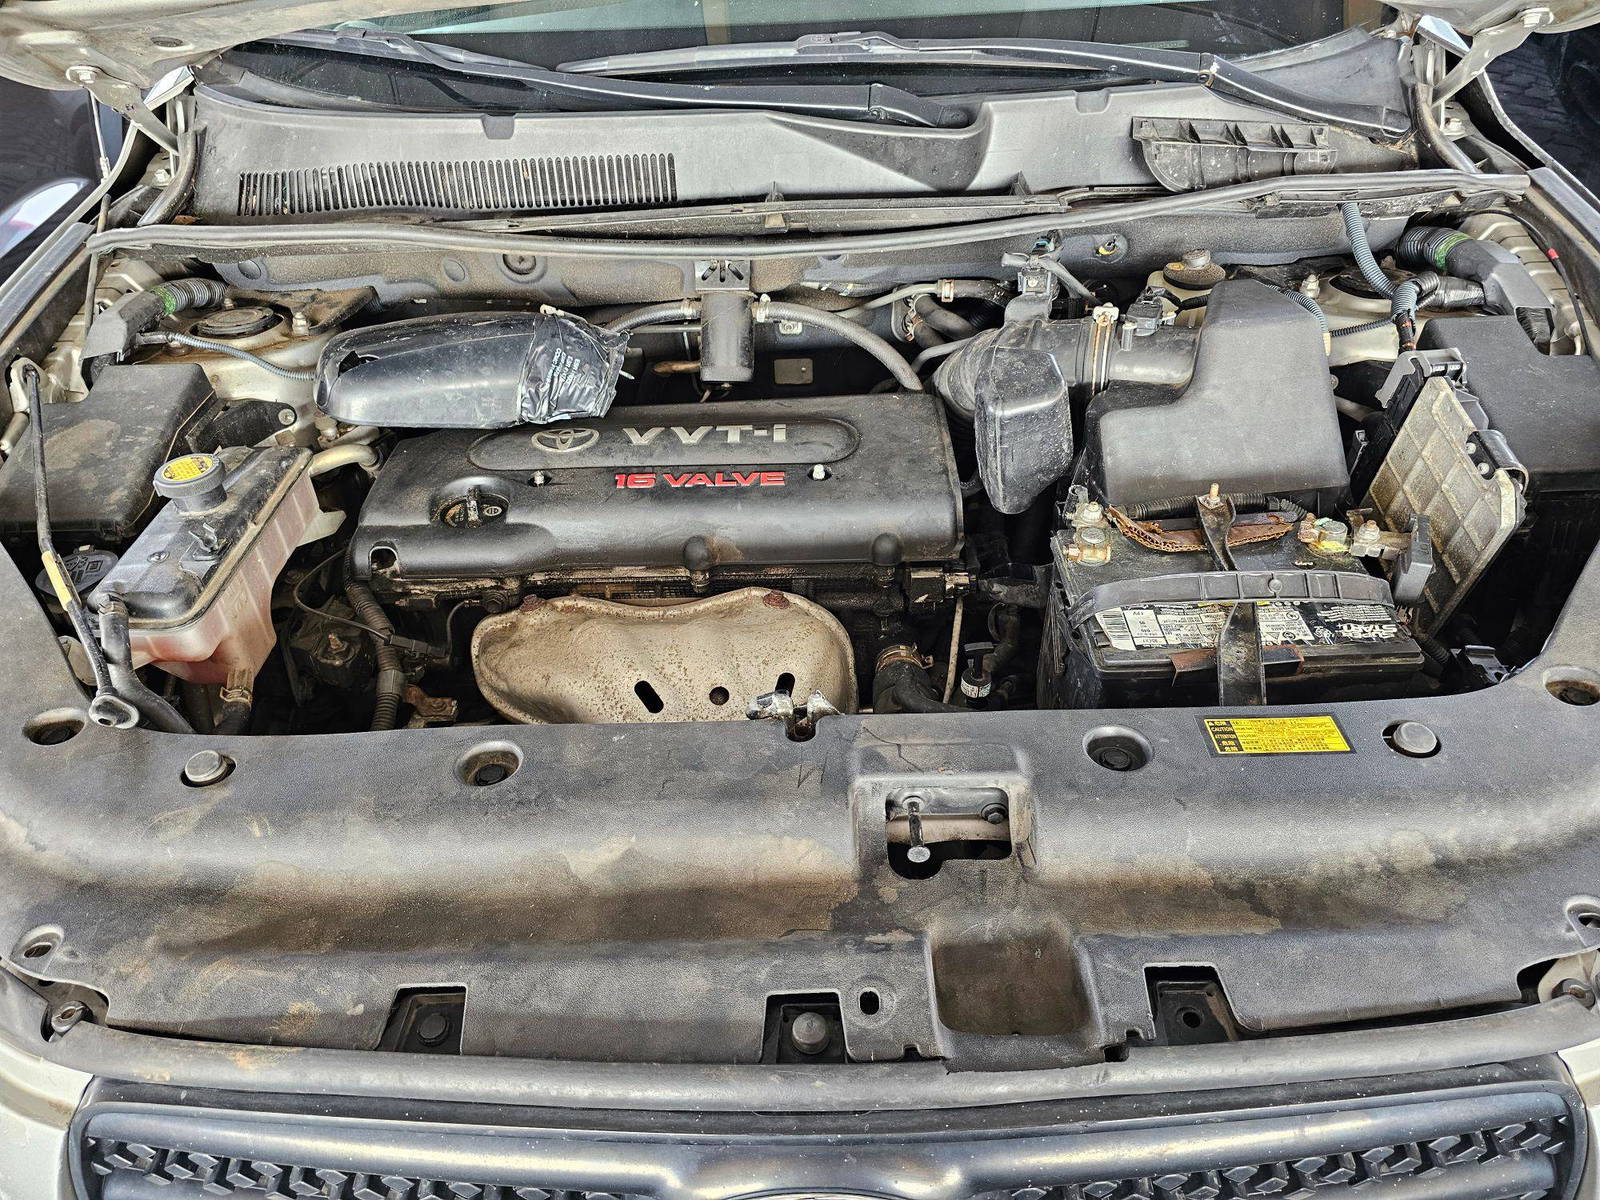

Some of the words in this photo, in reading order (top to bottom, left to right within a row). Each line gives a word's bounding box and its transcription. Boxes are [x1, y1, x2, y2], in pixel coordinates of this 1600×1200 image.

[615, 473, 656, 489] 16
[663, 471, 786, 488] VALVE
[1342, 623, 1398, 632] START
[1341, 630, 1396, 639] SUPER
